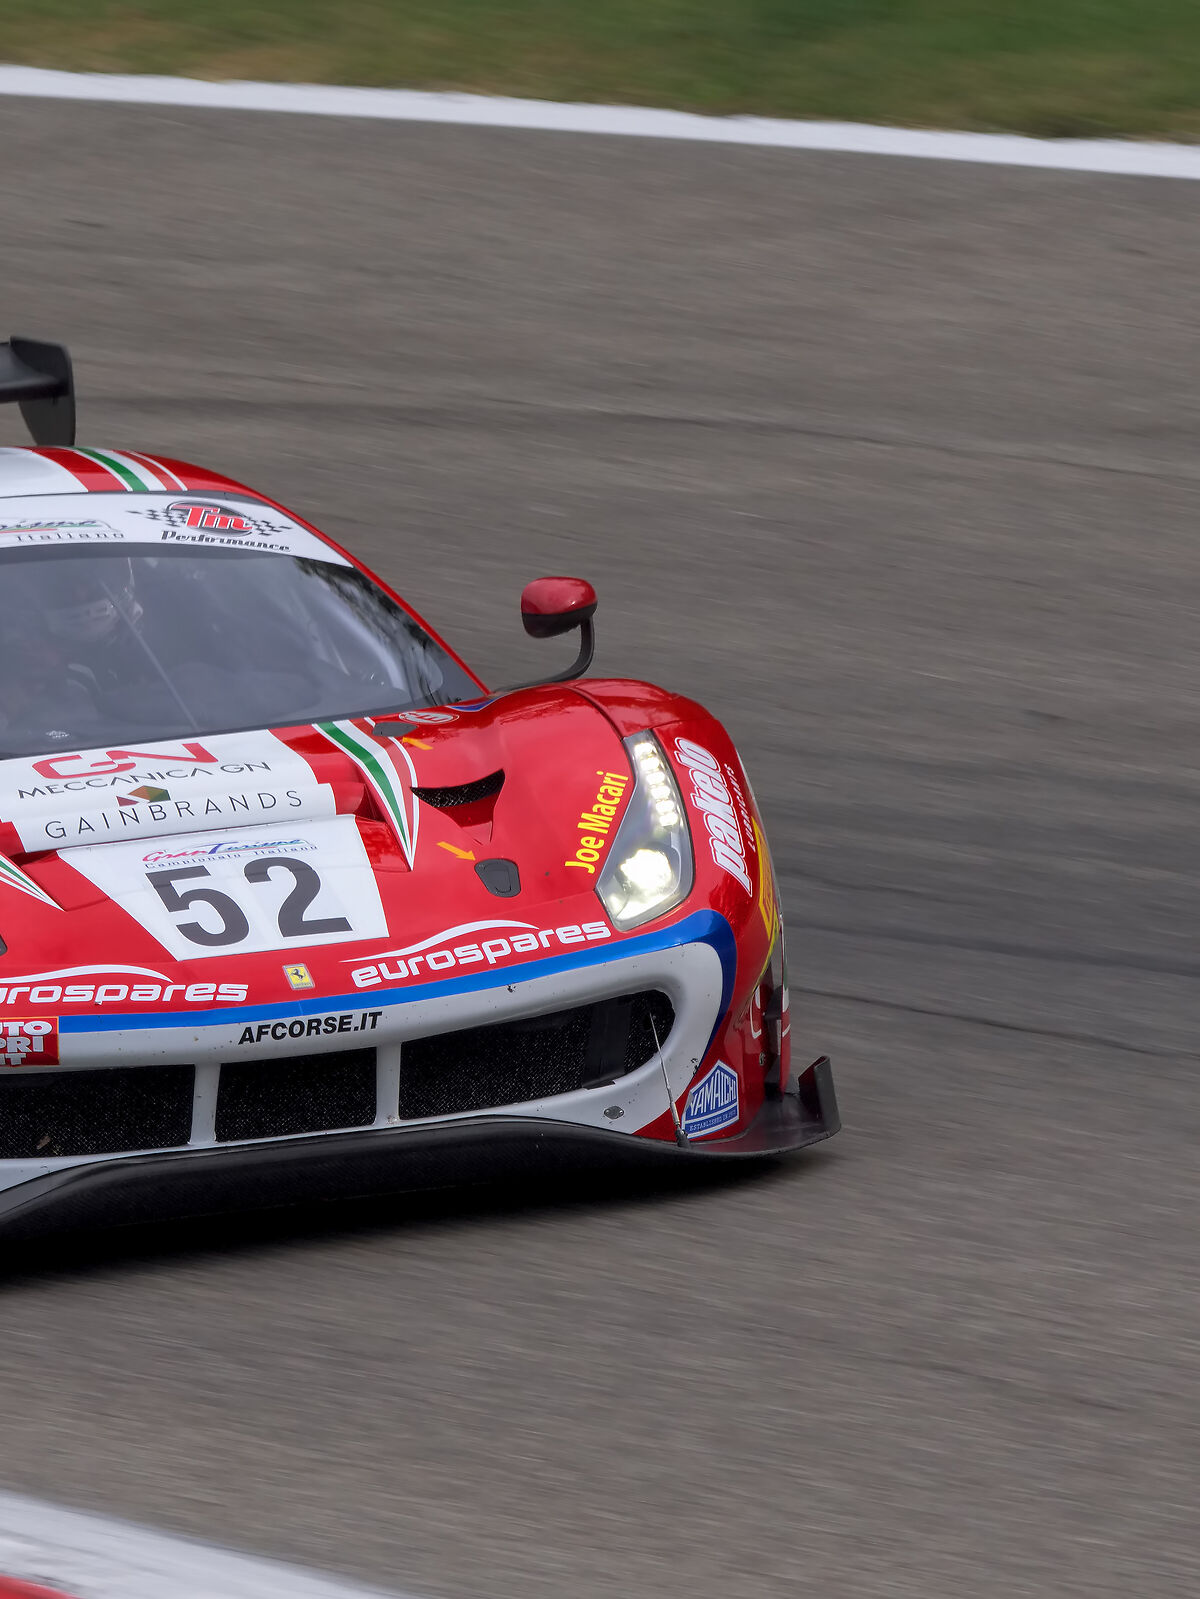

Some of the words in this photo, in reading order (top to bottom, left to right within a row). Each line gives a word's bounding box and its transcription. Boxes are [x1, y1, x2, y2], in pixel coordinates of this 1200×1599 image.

[16, 531, 126, 543] Italiano
[160, 530, 291, 552] Performance
[18, 767, 213, 799] MECCANICA
[220, 761, 272, 773] GN
[577, 770, 629, 834] Macari
[44, 790, 303, 840] GAINBRANDS
[674, 737, 753, 897] pakelo
[724, 763, 756, 853] LUBRICANTS
[144, 853, 241, 869] Campionato
[254, 845, 318, 856] Italiano
[564, 836, 605, 874] Joe
[145, 856, 355, 947] 52
[351, 920, 613, 988] eurospares
[238, 1010, 383, 1046] AFCORSE.IT
[689, 1069, 737, 1117] YAMAICHI
